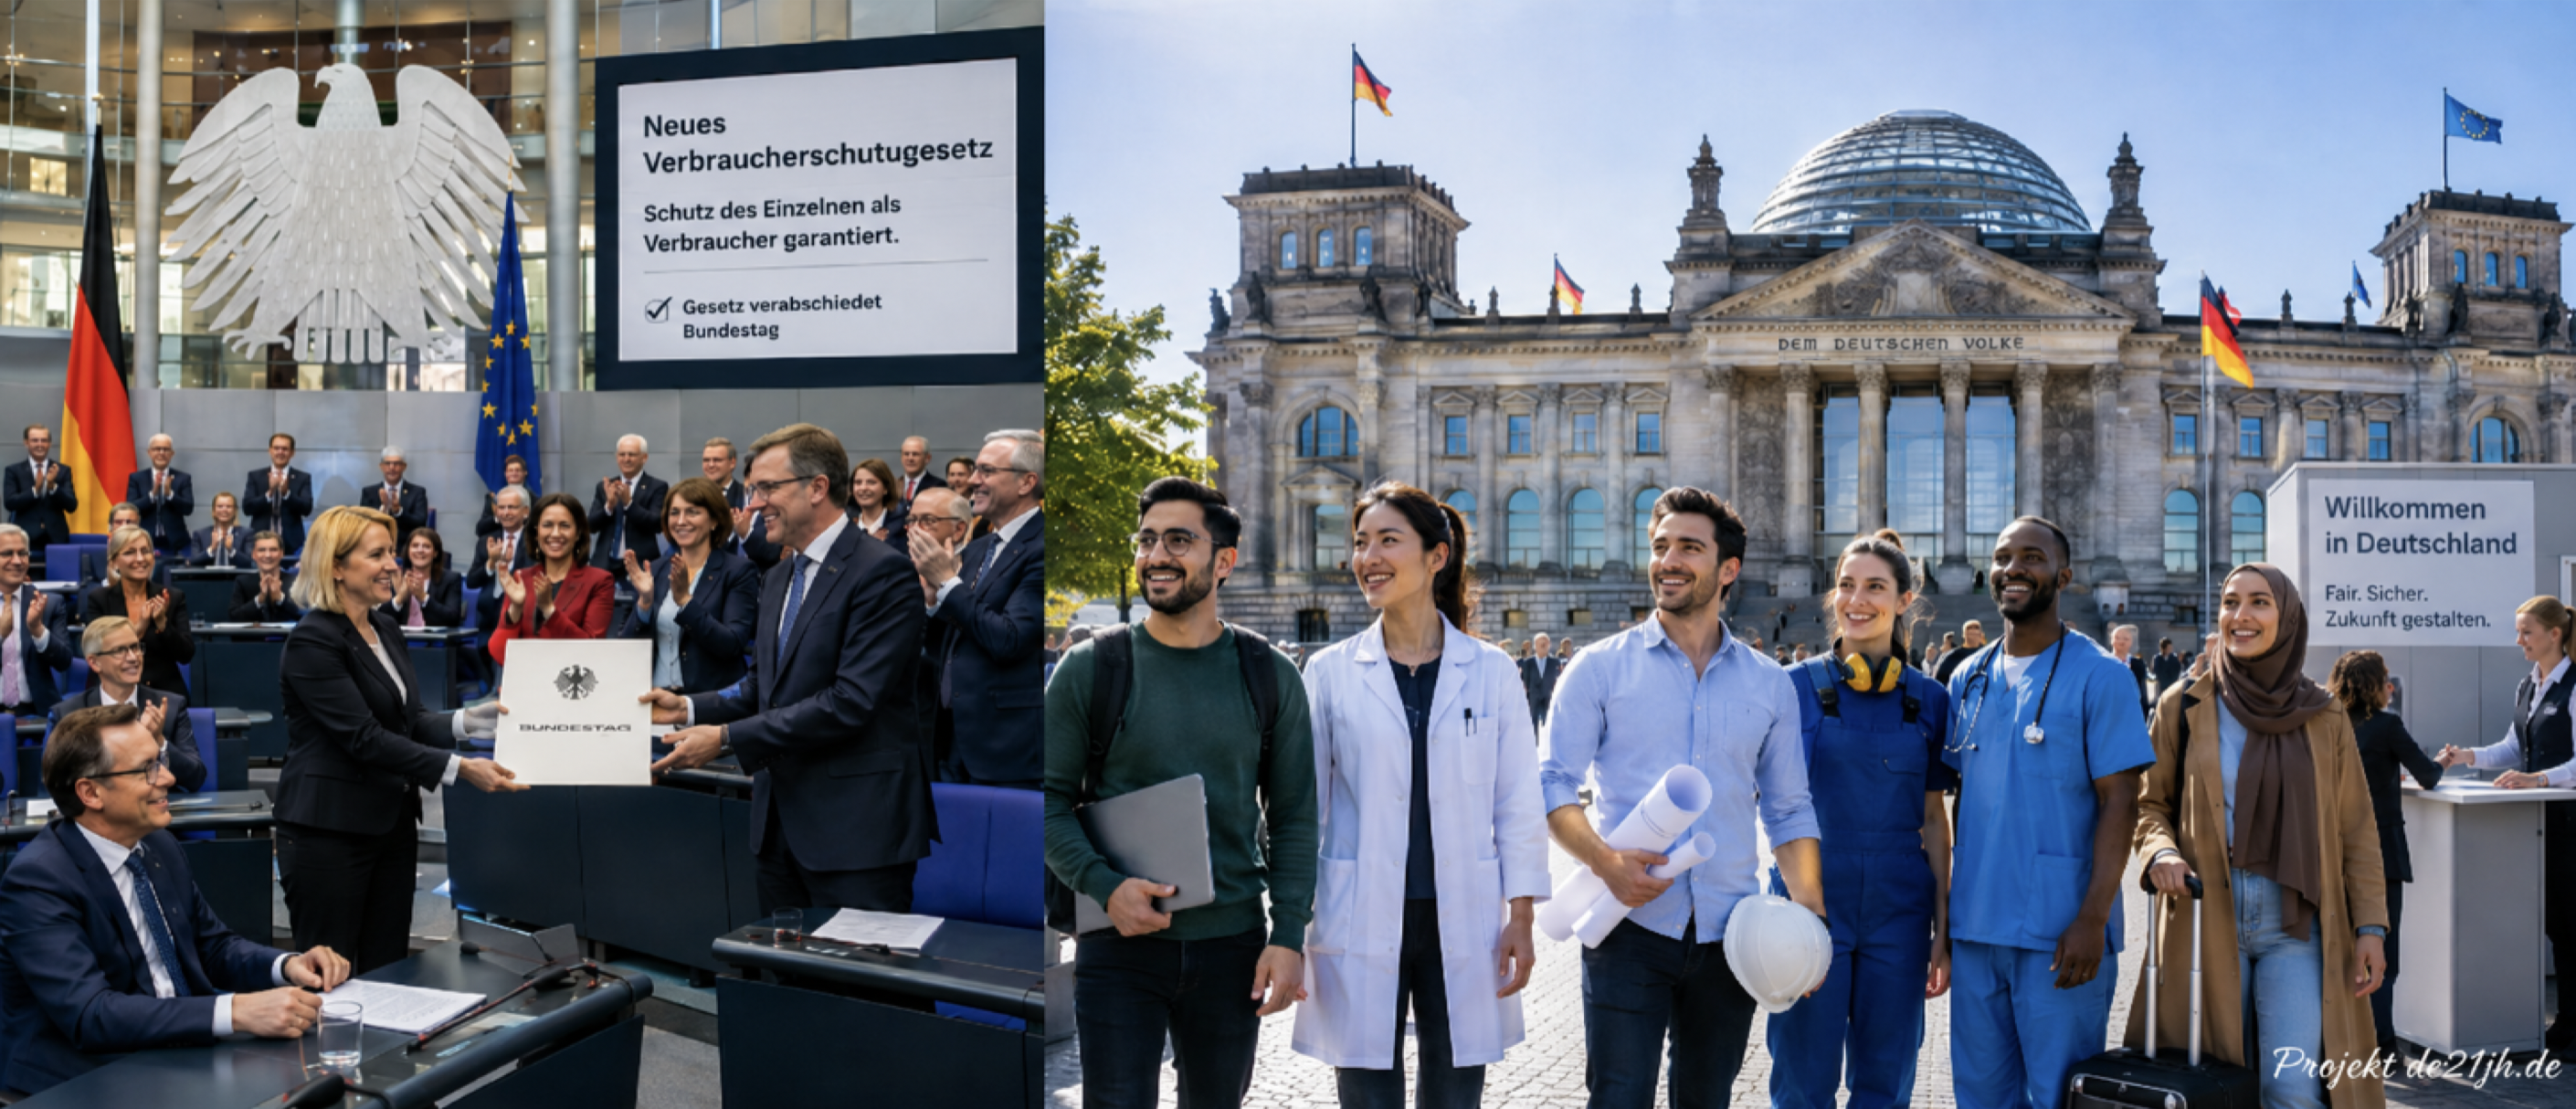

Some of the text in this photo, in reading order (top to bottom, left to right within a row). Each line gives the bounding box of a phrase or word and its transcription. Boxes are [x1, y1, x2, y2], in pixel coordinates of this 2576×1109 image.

[644, 114, 726, 137] Neues
[643, 137, 994, 174] Verbraucherschutugesetz
[644, 195, 901, 223] Schutz des Einzelnen als
[644, 227, 900, 254] Verbraucher garantiert.
[682, 294, 882, 316] Gesetz verabschiedet
[682, 322, 779, 341] Bundestag
[1778, 336, 2024, 351] DEM DEUTSCHEN VOLKE
[2325, 496, 2486, 520] Willkommen
[2326, 531, 2518, 555] in Deutschland
[2325, 585, 2429, 603] Fair. Sicher.
[2325, 609, 2492, 631] Zukunft gestalten.
[519, 723, 632, 733] BUNDESTAG
